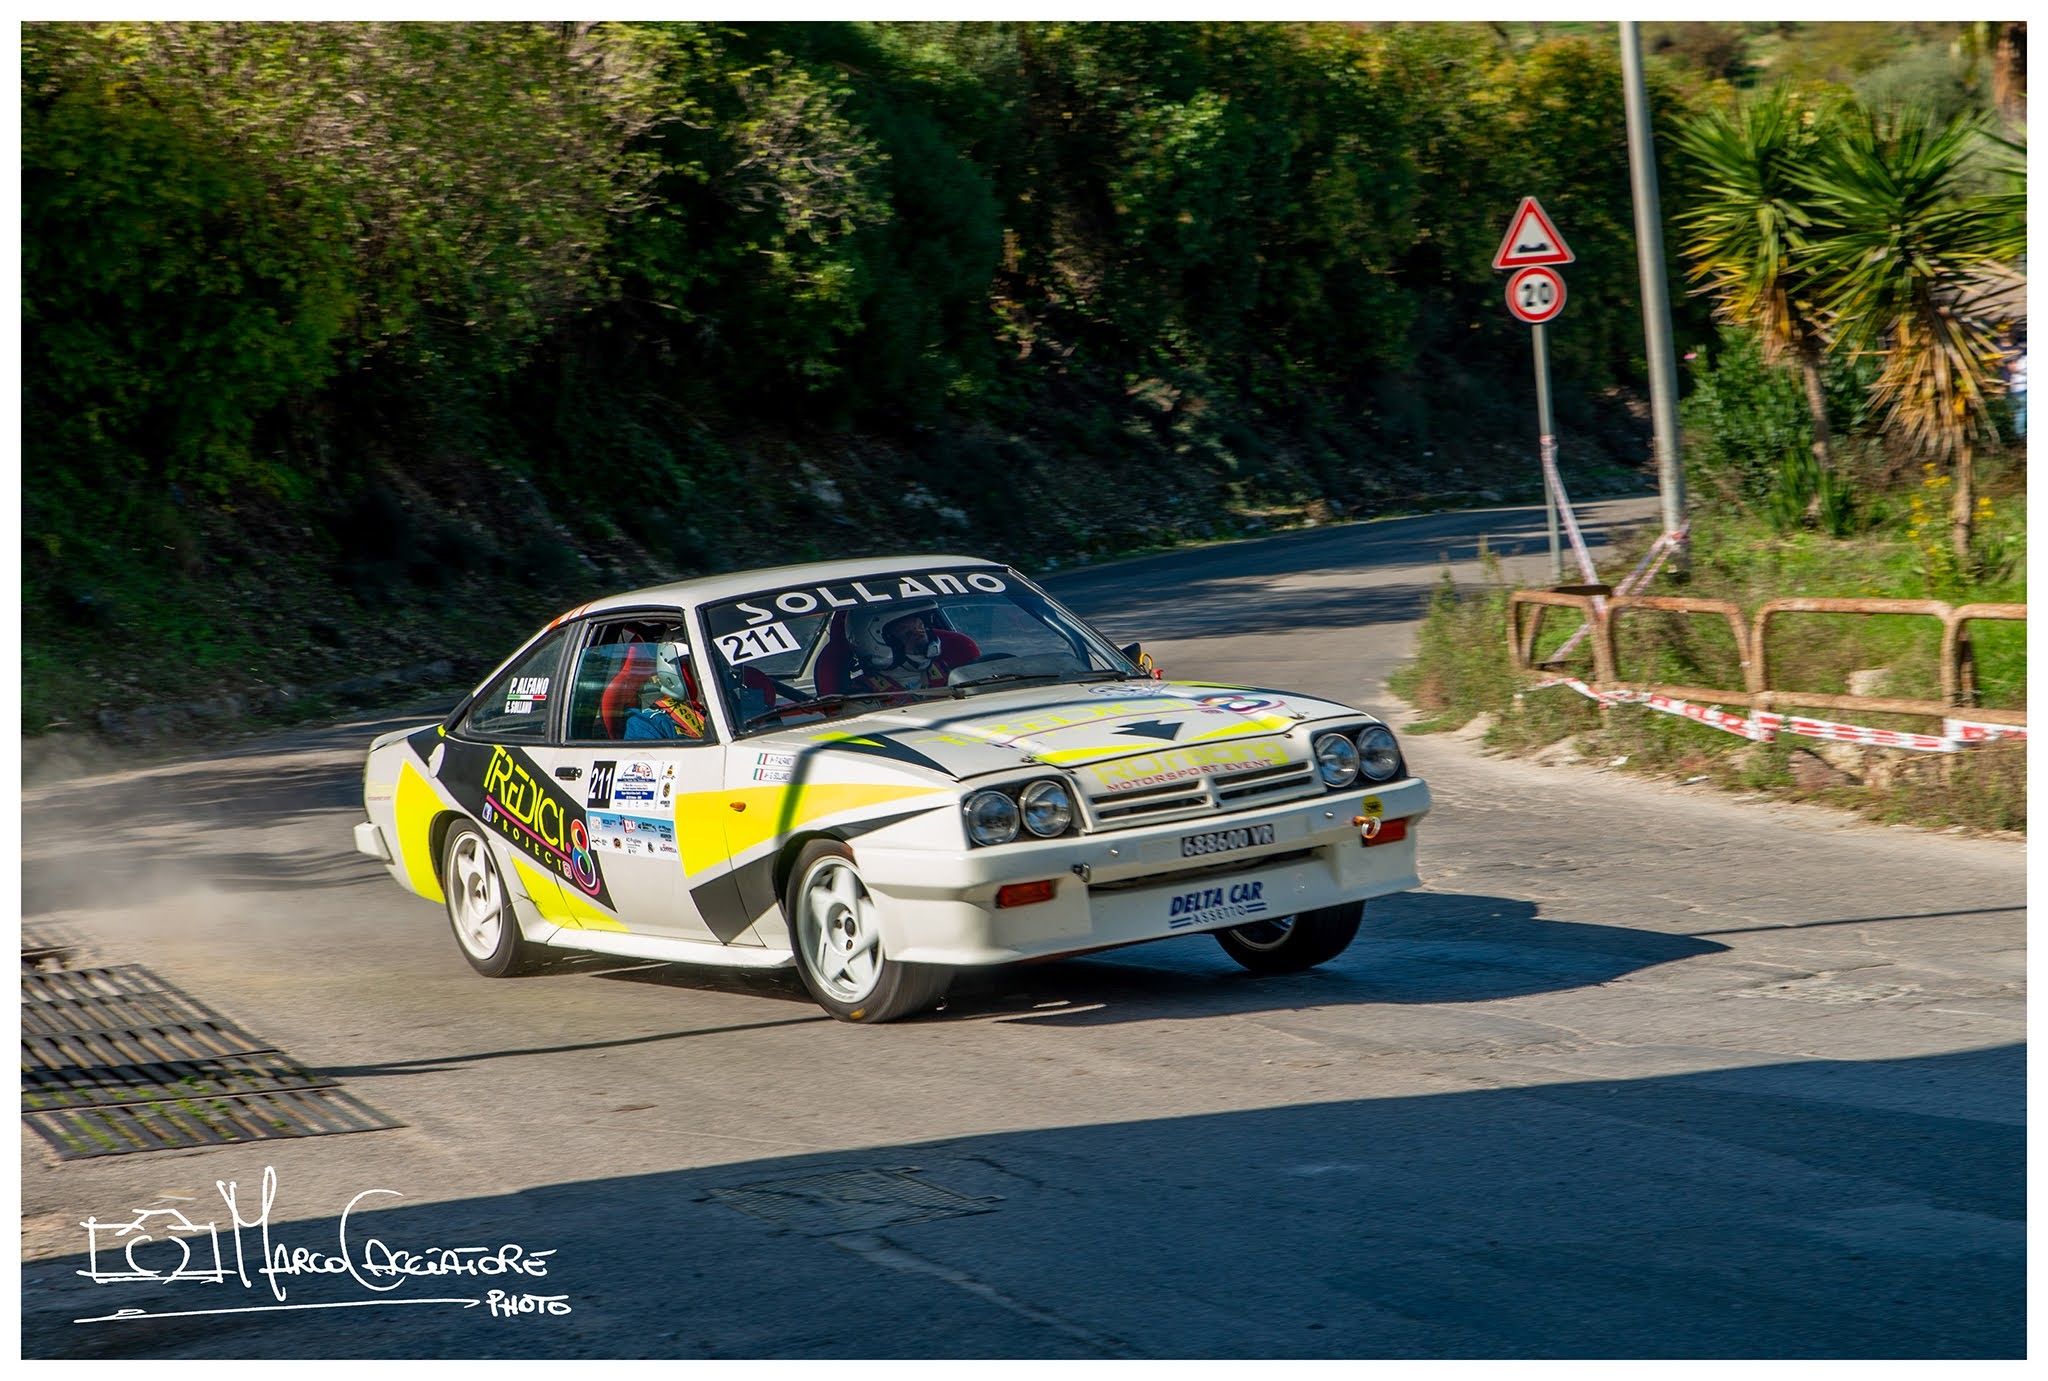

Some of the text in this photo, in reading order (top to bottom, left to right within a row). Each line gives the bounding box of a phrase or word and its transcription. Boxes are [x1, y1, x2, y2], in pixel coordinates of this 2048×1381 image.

[1521, 282, 1554, 308] 20
[736, 573, 1007, 625] SOLLANO
[722, 624, 790, 662] 211
[516, 677, 549, 695] ALFANO
[588, 767, 614, 800] 211
[1106, 758, 1273, 793] MOTORSPORT EVENT
[493, 811, 563, 871] PROJECT
[1183, 824, 1274, 857] 688600 VR
[1169, 881, 1264, 917] DELTA CAR
[1191, 904, 1248, 925] ASSETTO
